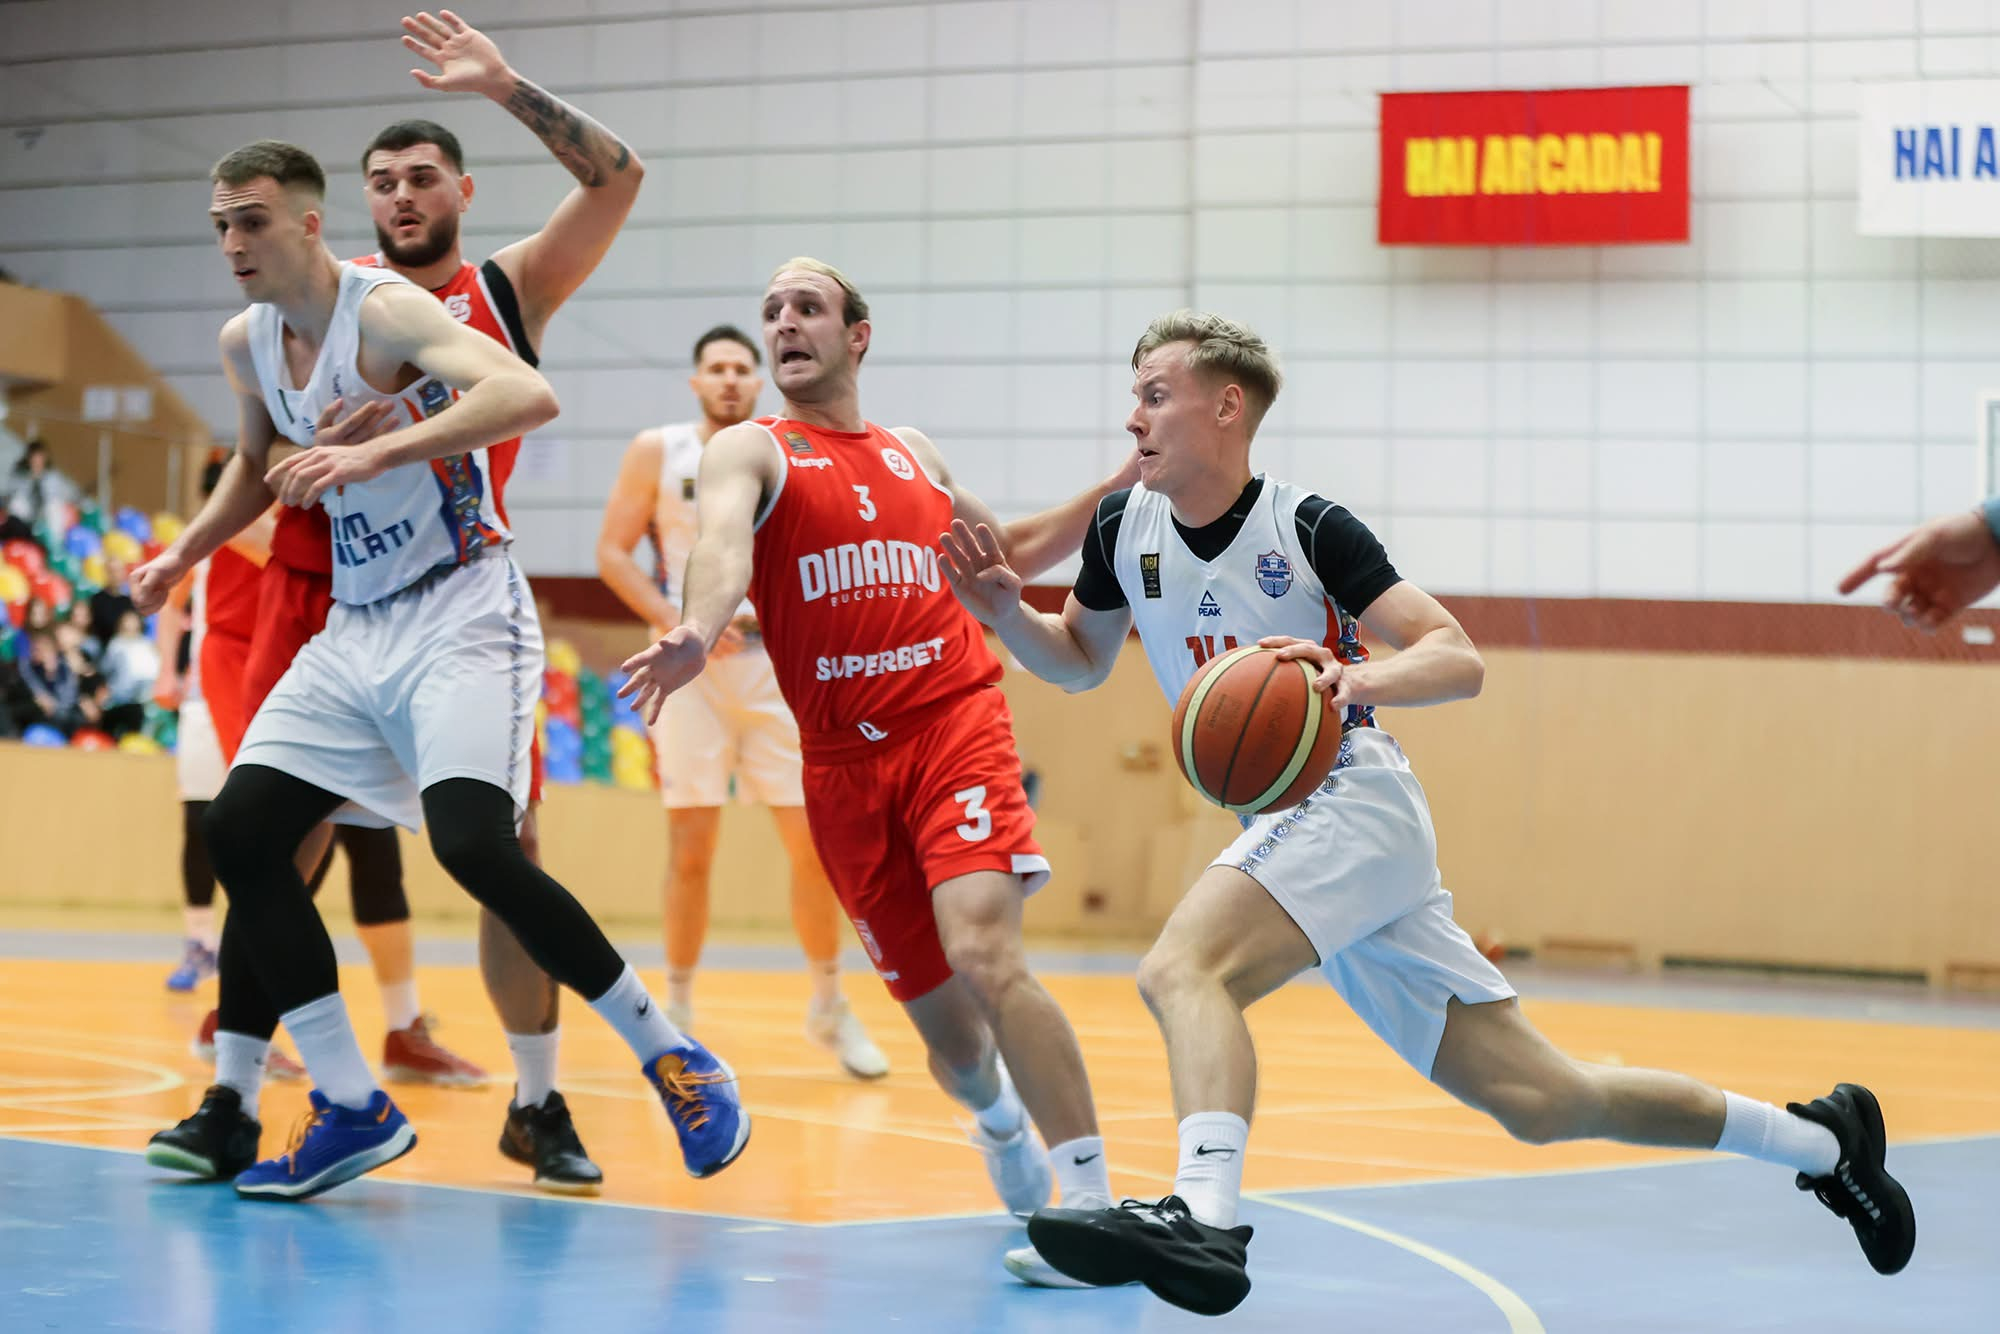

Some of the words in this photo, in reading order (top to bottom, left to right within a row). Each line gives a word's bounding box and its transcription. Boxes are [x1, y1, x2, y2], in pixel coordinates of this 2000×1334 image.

[1406, 136, 1476, 197] HAI
[1481, 131, 1662, 195] ARCADA!
[1894, 126, 1961, 179] HAI
[852, 484, 878, 522] 3
[797, 539, 941, 602] DINAMO
[1198, 607, 1222, 617] PEAK
[816, 637, 945, 681] SUPERBET
[954, 785, 992, 842] 3
